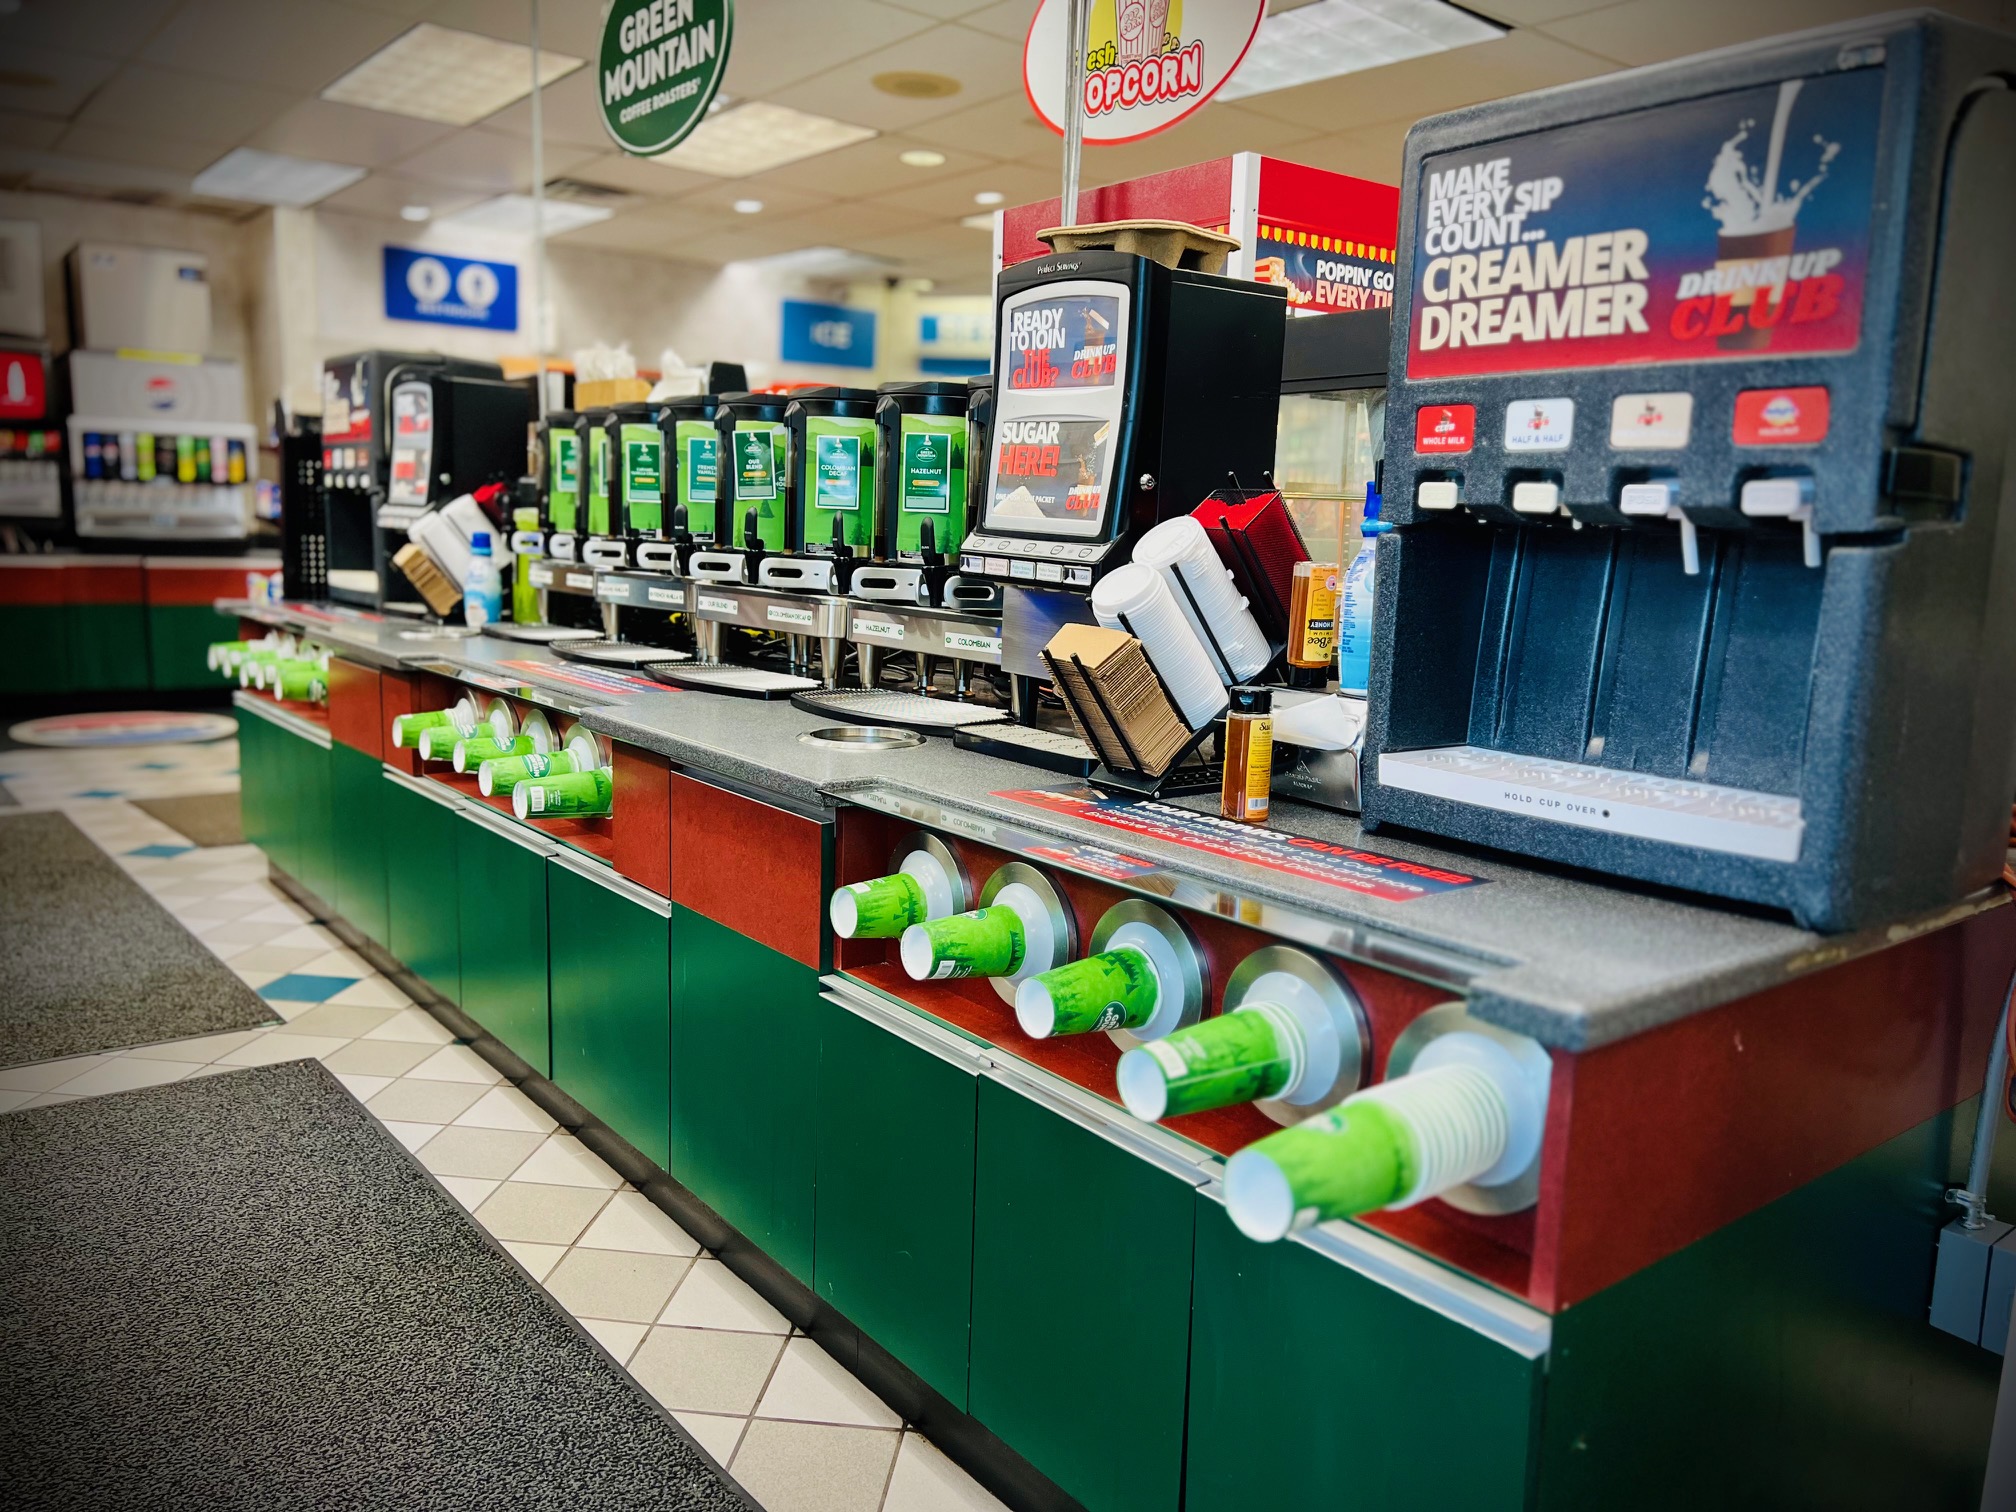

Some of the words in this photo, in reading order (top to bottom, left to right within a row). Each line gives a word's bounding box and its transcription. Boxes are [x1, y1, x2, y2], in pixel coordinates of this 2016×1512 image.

[619, 0, 694, 54] GREEN
[604, 18, 715, 106] MOUNTAIN
[1086, 40, 1116, 71] esh
[1084, 41, 1202, 116] OPCORN
[619, 97, 653, 125] COFFEE
[1429, 157, 1512, 202] MAKE
[1426, 185, 1513, 230] EVERY
[1513, 177, 1564, 215] SIP
[1424, 212, 1547, 256] COUNT...
[1316, 259, 1372, 287] POPPIN'
[1373, 269, 1394, 292] GO
[1422, 228, 1650, 303] CREAMER
[1676, 255, 1790, 301] DRINK
[1789, 247, 1843, 282] UP
[1315, 279, 1370, 310] EVERY
[1372, 289, 1394, 309] TI
[1669, 273, 1846, 341] CLUB
[1013, 308, 1064, 333] READY
[1419, 282, 1650, 351] DREAMER
[1010, 331, 1030, 352] TO
[1031, 327, 1066, 351] JOIN
[1073, 345, 1103, 361] DRINK
[1103, 343, 1116, 355] UP
[1023, 348, 1051, 370] THE
[1070, 354, 1117, 380] CLUB
[1012, 366, 1060, 389] CLUB?
[1001, 421, 1060, 445] SUGAR
[1422, 436, 1447, 445] WHOLE
[1447, 436, 1465, 445] MILK
[1511, 435, 1531, 444] HALF
[1543, 434, 1563, 443] HALF
[910, 467, 942, 475] HAZELNUT
[997, 444, 1061, 477] HERE!
[1036, 495, 1056, 504] PACKET
[773, 610, 795, 619] COLOMBIAN
[865, 624, 891, 634] HAZELNUT
[957, 637, 991, 648] COLOMBIAN
[1503, 791, 1532, 803] HOLD
[1539, 798, 1561, 808] CUP
[1566, 803, 1597, 815] OVER
[1084, 810, 1148, 829] Exclusive
[1181, 836, 1208, 847] Oil
[1204, 841, 1241, 854] and
[1238, 851, 1284, 865] Food
[1283, 862, 1376, 889] Discounts
[1132, 800, 1200, 818] YOUR
[1194, 816, 1295, 840] DRINKS
[1287, 837, 1354, 856] CAN
[1348, 852, 1393, 866] BE
[1386, 862, 1474, 884] FREE!
[1188, 823, 1235, 836] Drinks
[1264, 841, 1300, 853] Day
[1300, 850, 1325, 859] on
[1343, 860, 1383, 874] Cup
[1287, 854, 1335, 868] Soda
[1334, 866, 1376, 880] and
[1371, 877, 1425, 892] more
